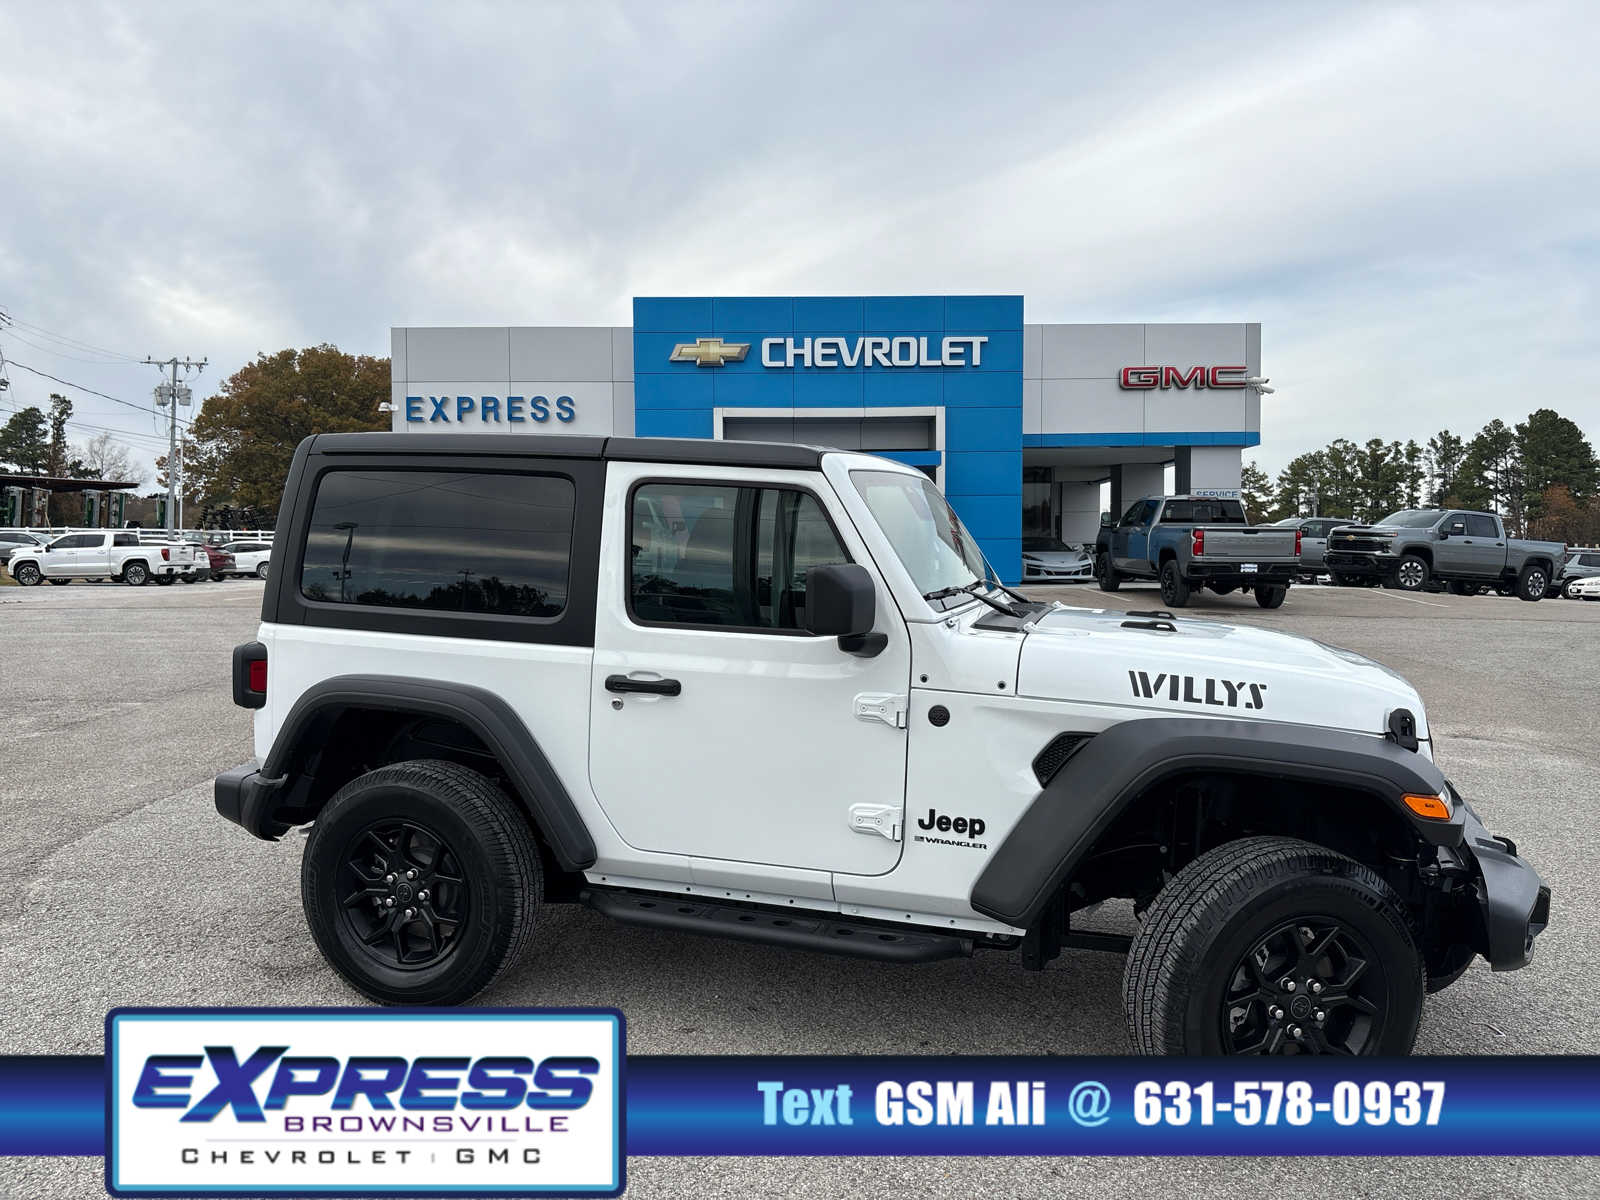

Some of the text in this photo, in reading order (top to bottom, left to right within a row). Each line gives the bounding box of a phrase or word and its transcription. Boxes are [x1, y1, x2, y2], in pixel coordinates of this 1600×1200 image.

[761, 336, 989, 368] CHEVROLET
[1120, 366, 1248, 389] GMC
[405, 395, 576, 424] EXPRESS
[1128, 670, 1267, 710] WILLYS
[917, 808, 986, 839] Jeep
[924, 836, 987, 850] WRANGLER
